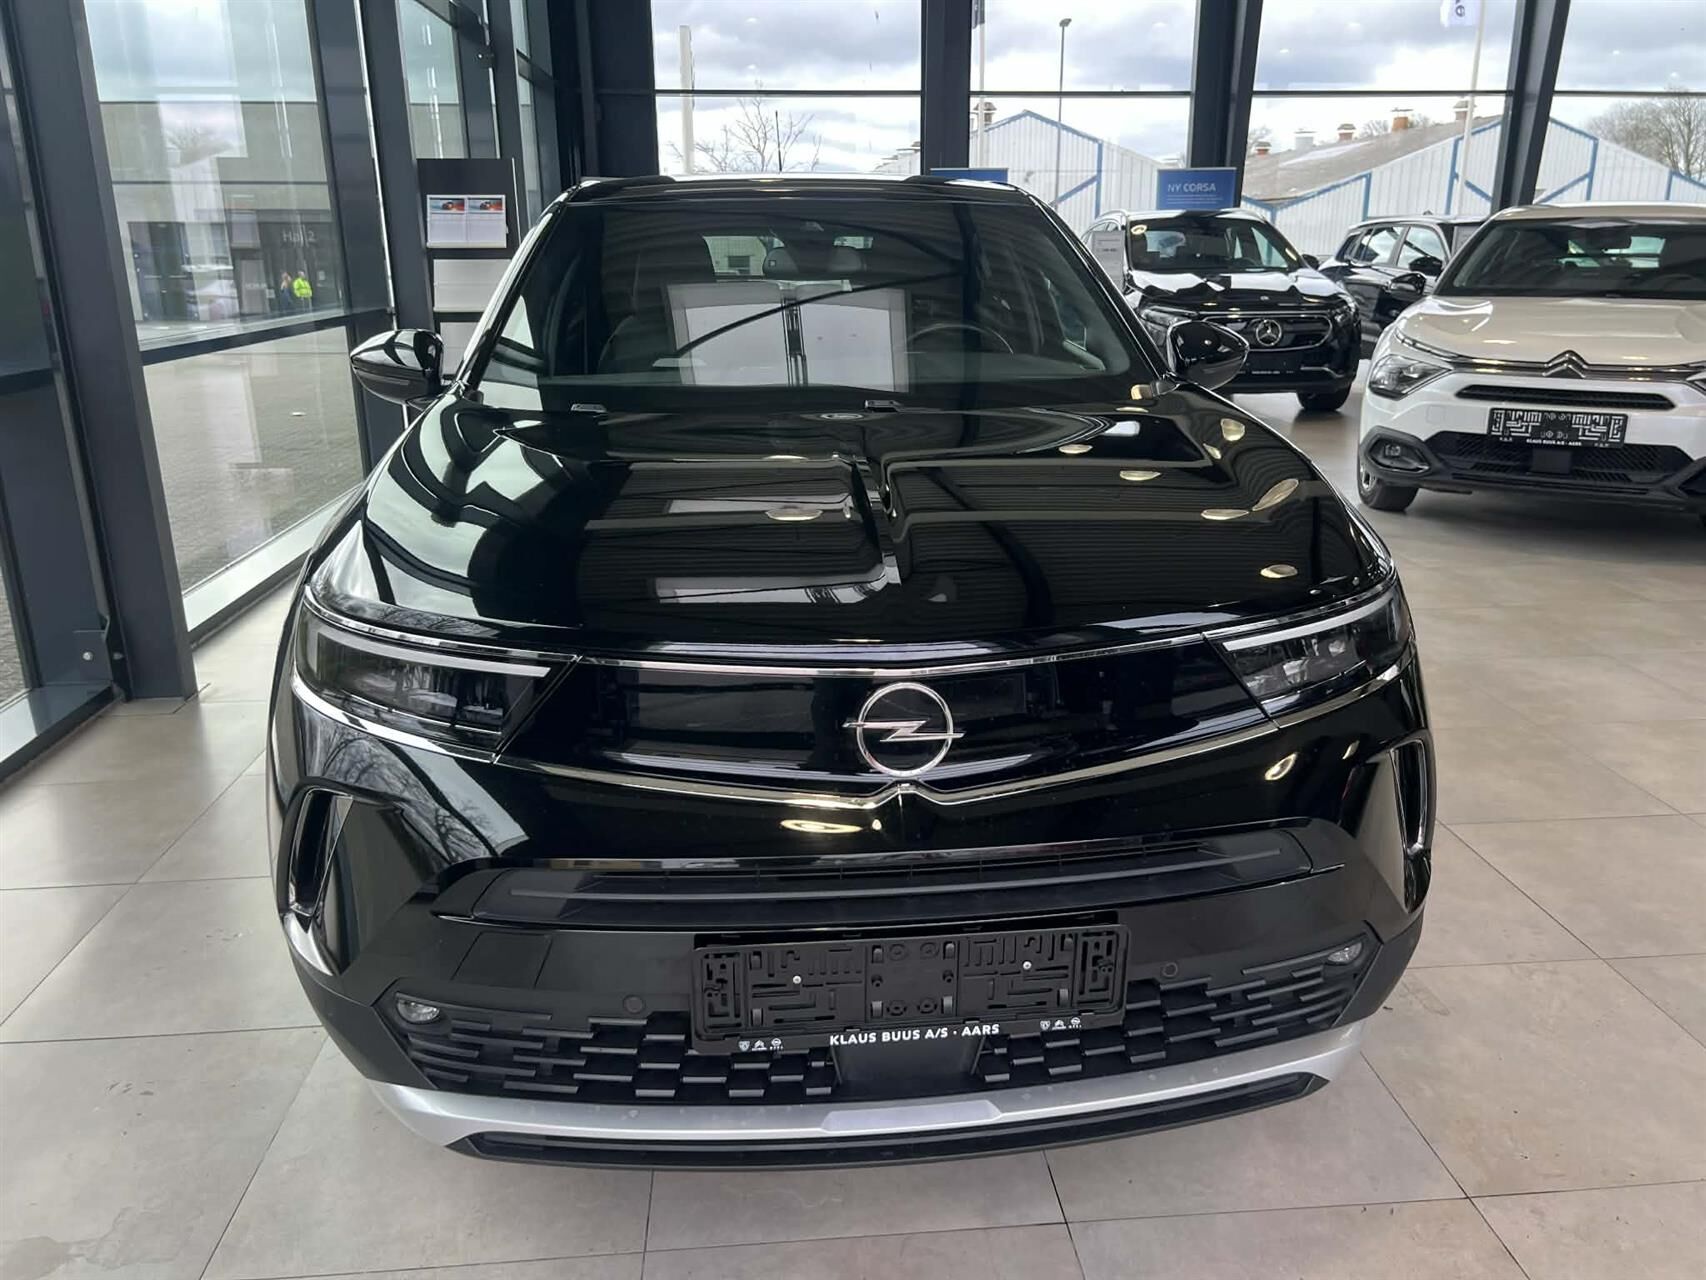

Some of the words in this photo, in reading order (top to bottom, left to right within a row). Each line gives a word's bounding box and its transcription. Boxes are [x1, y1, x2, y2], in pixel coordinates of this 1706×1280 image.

[1167, 184, 1181, 192] NY
[1183, 183, 1216, 192] CORSA
[829, 1032, 877, 1046] KLAUS
[881, 1029, 921, 1042] BUUS
[924, 1027, 948, 1039] A/S
[961, 1024, 1000, 1037] AARS
